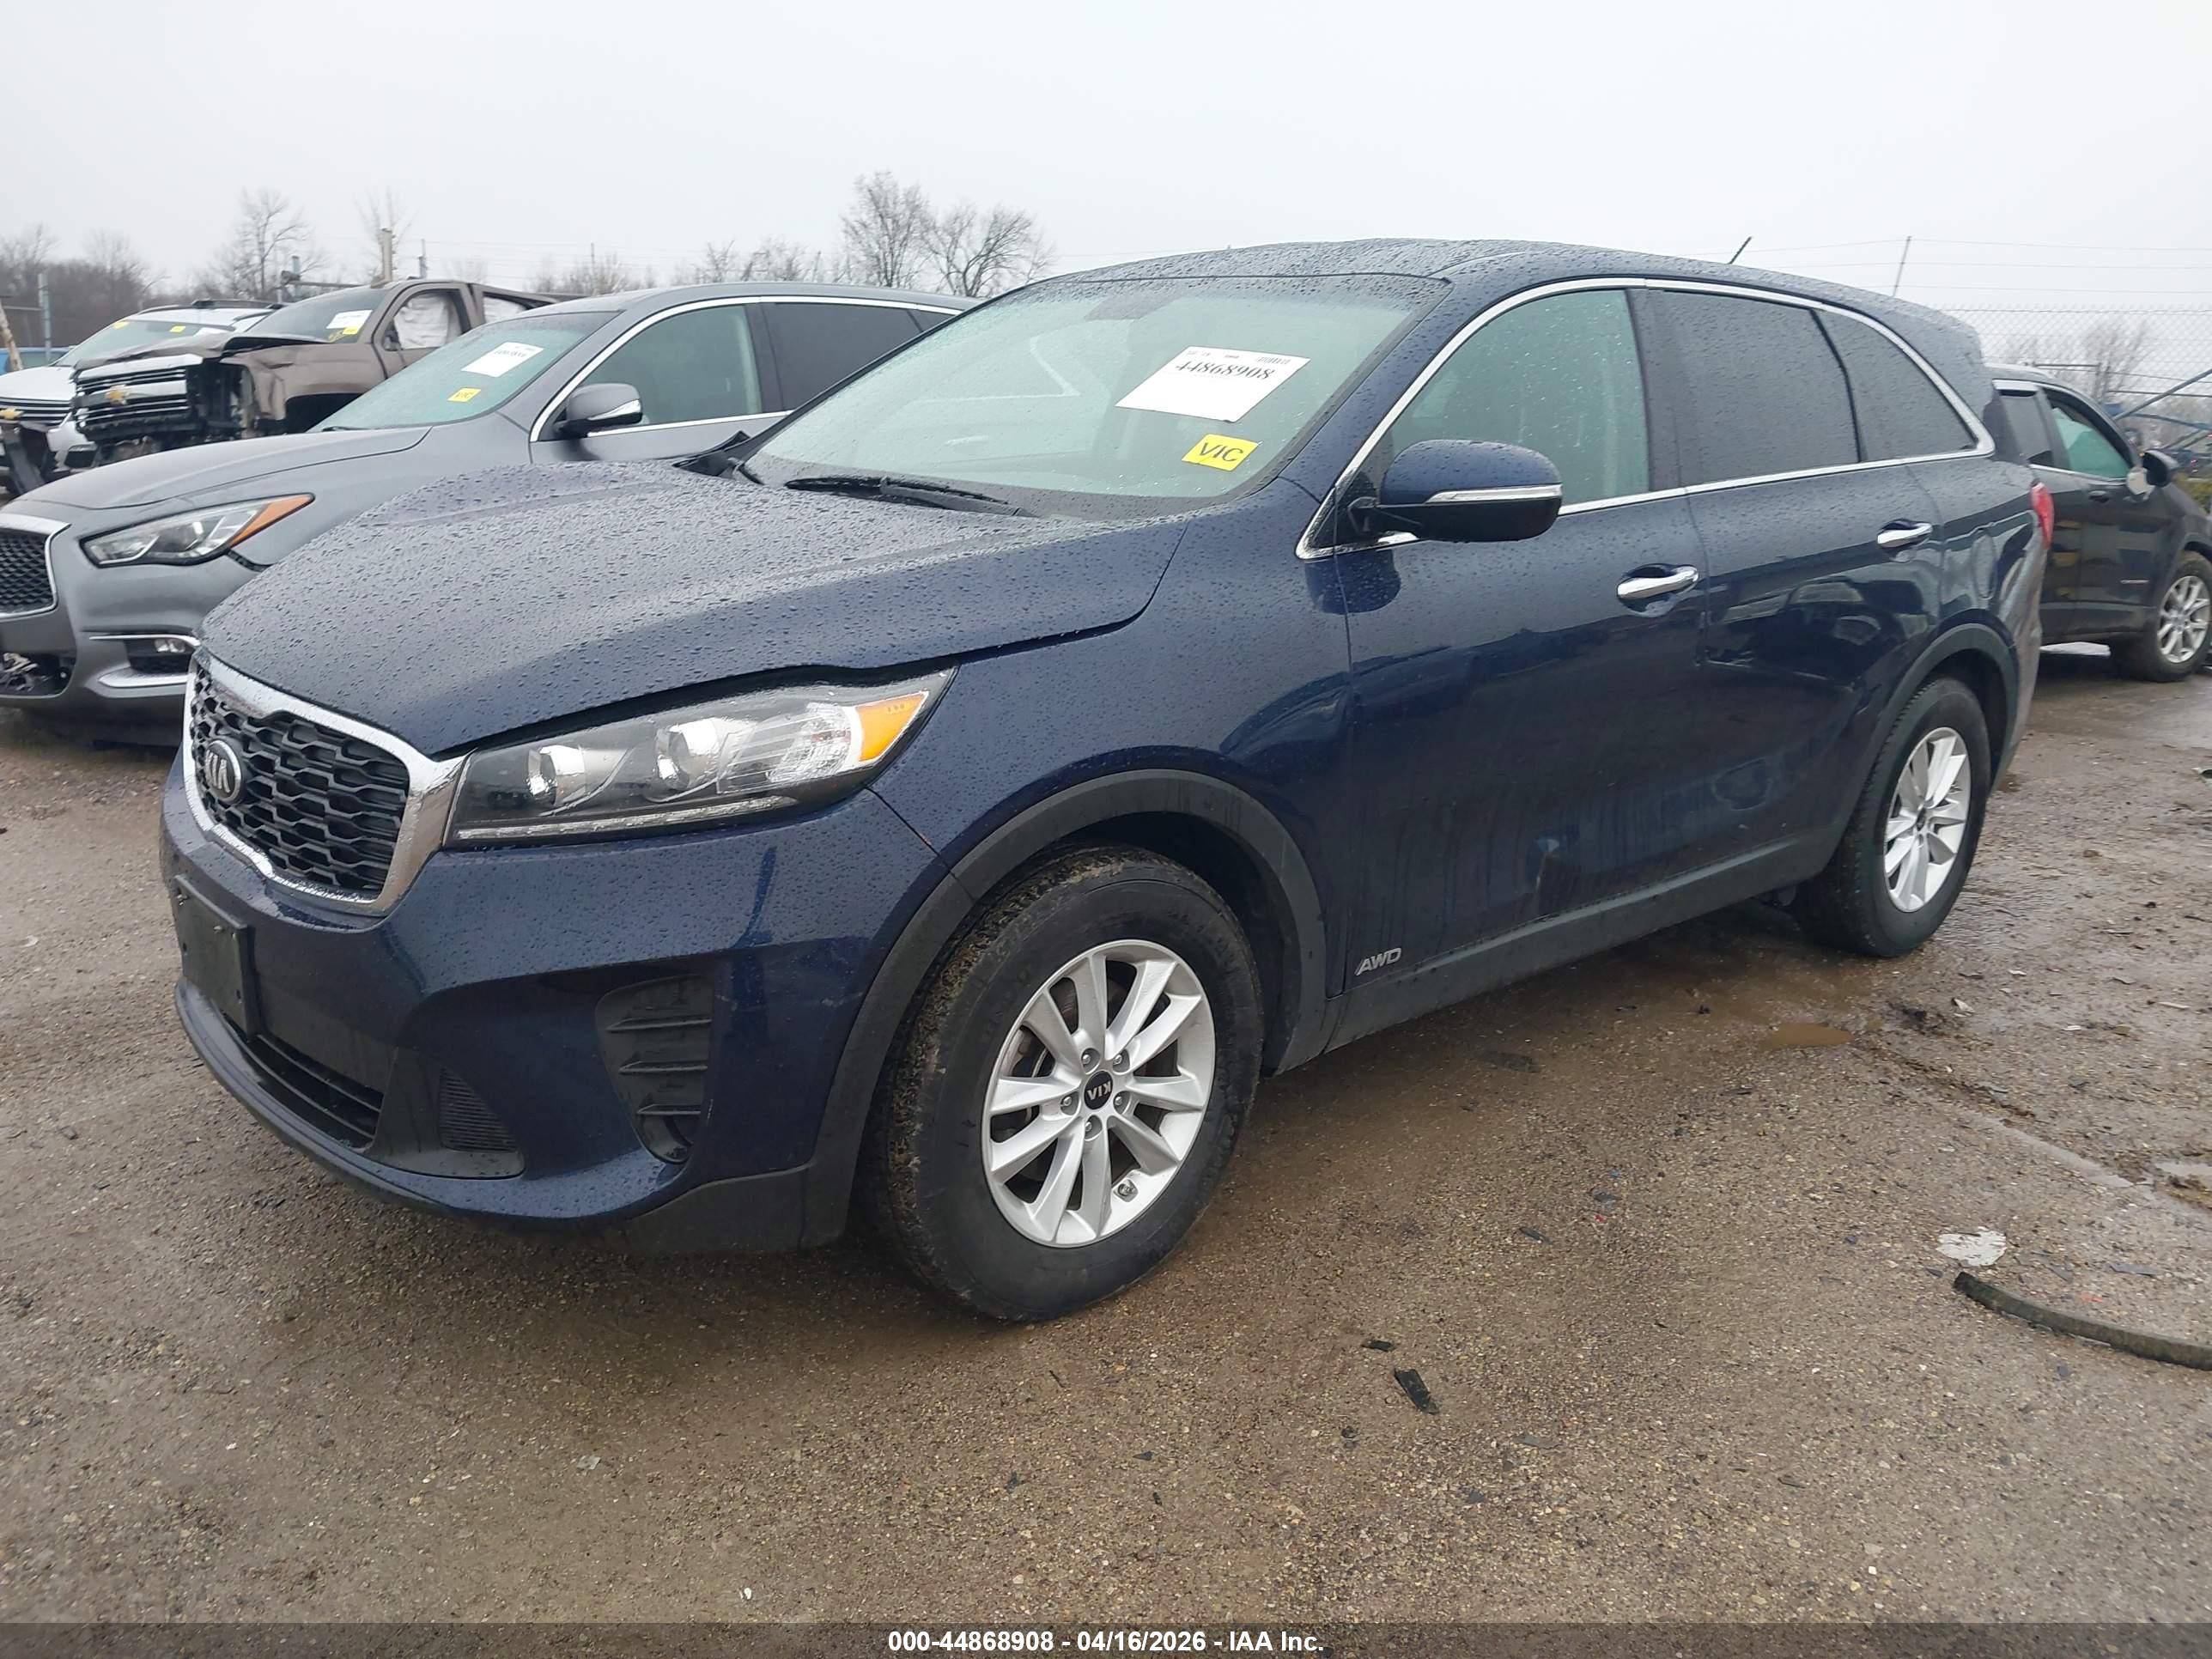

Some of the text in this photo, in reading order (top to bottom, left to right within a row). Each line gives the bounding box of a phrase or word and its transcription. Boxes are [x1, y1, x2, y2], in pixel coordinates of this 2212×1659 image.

[1175, 361, 1275, 380] 44868908
[1199, 441, 1244, 463] VIC
[1354, 947, 1402, 976] AWD
[1086, 1080, 1111, 1101] KIA
